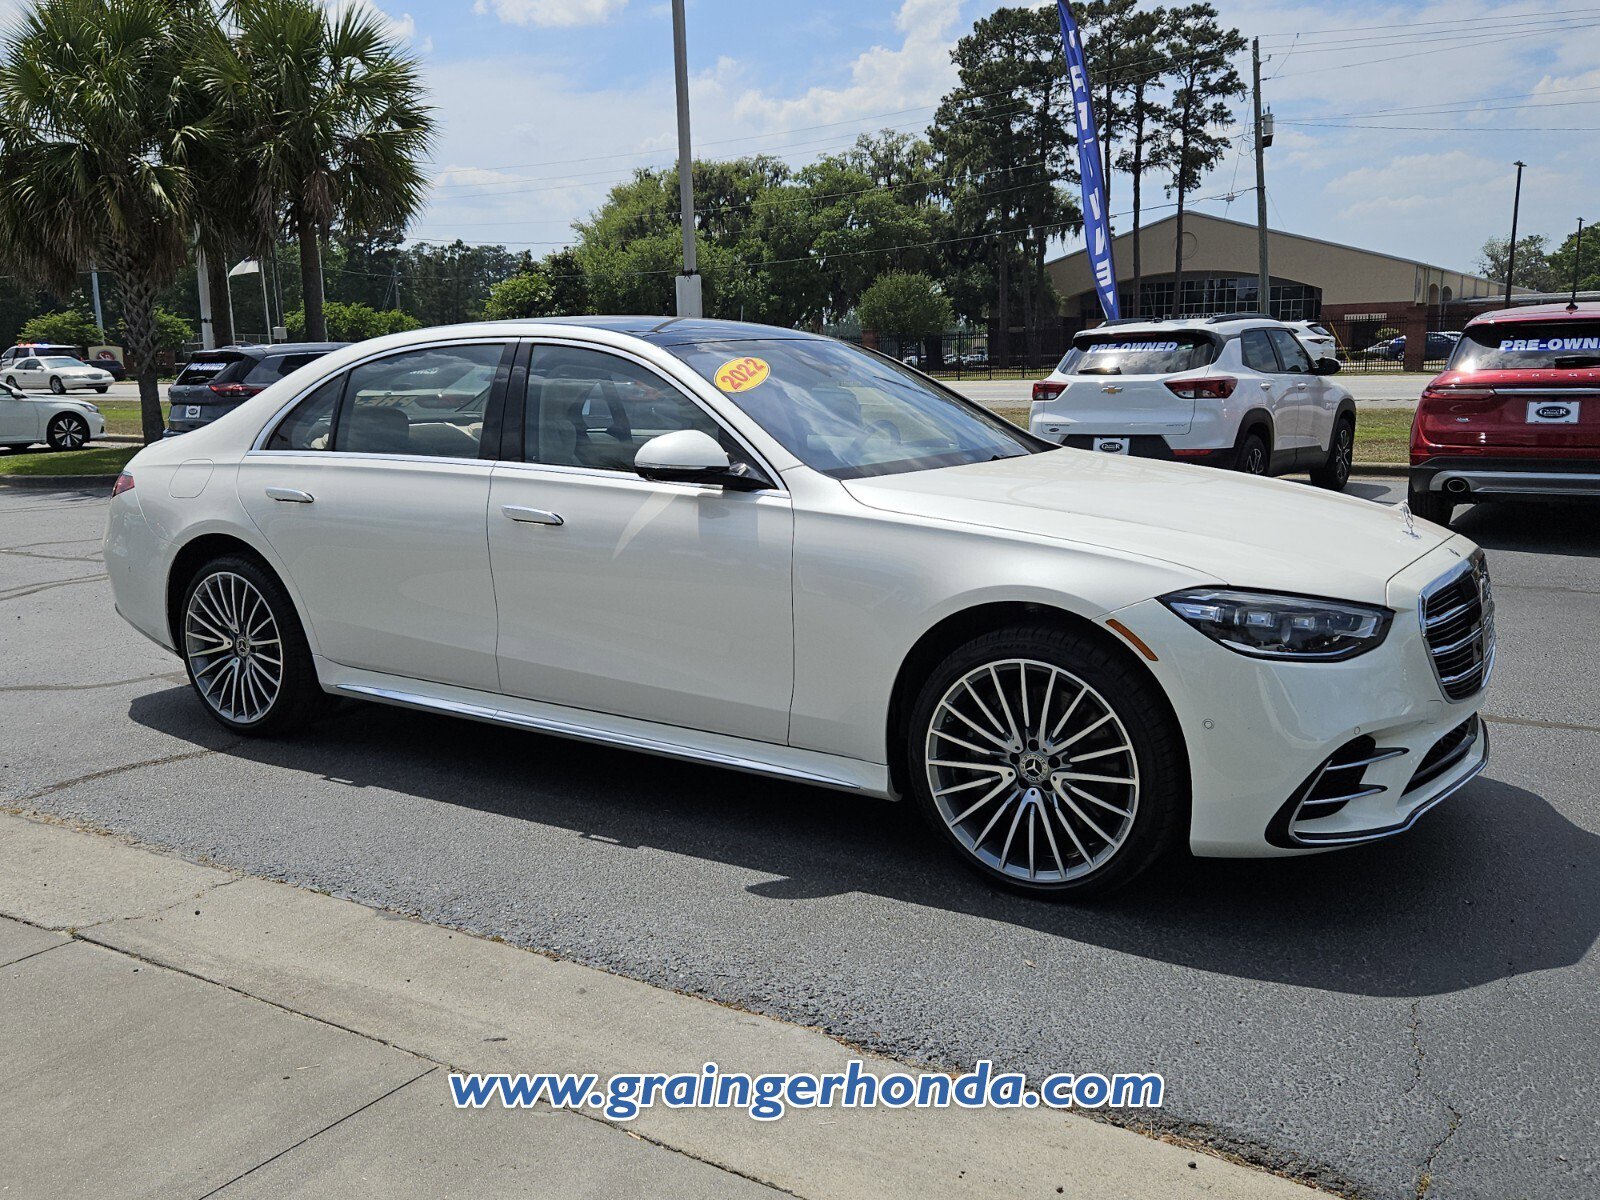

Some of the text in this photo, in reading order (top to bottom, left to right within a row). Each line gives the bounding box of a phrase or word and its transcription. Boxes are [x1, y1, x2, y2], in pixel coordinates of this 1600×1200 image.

[1087, 342, 1178, 353] PRE-OWNED
[1499, 338, 1600, 351] PRE-OWN
[721, 358, 764, 390] 2022
